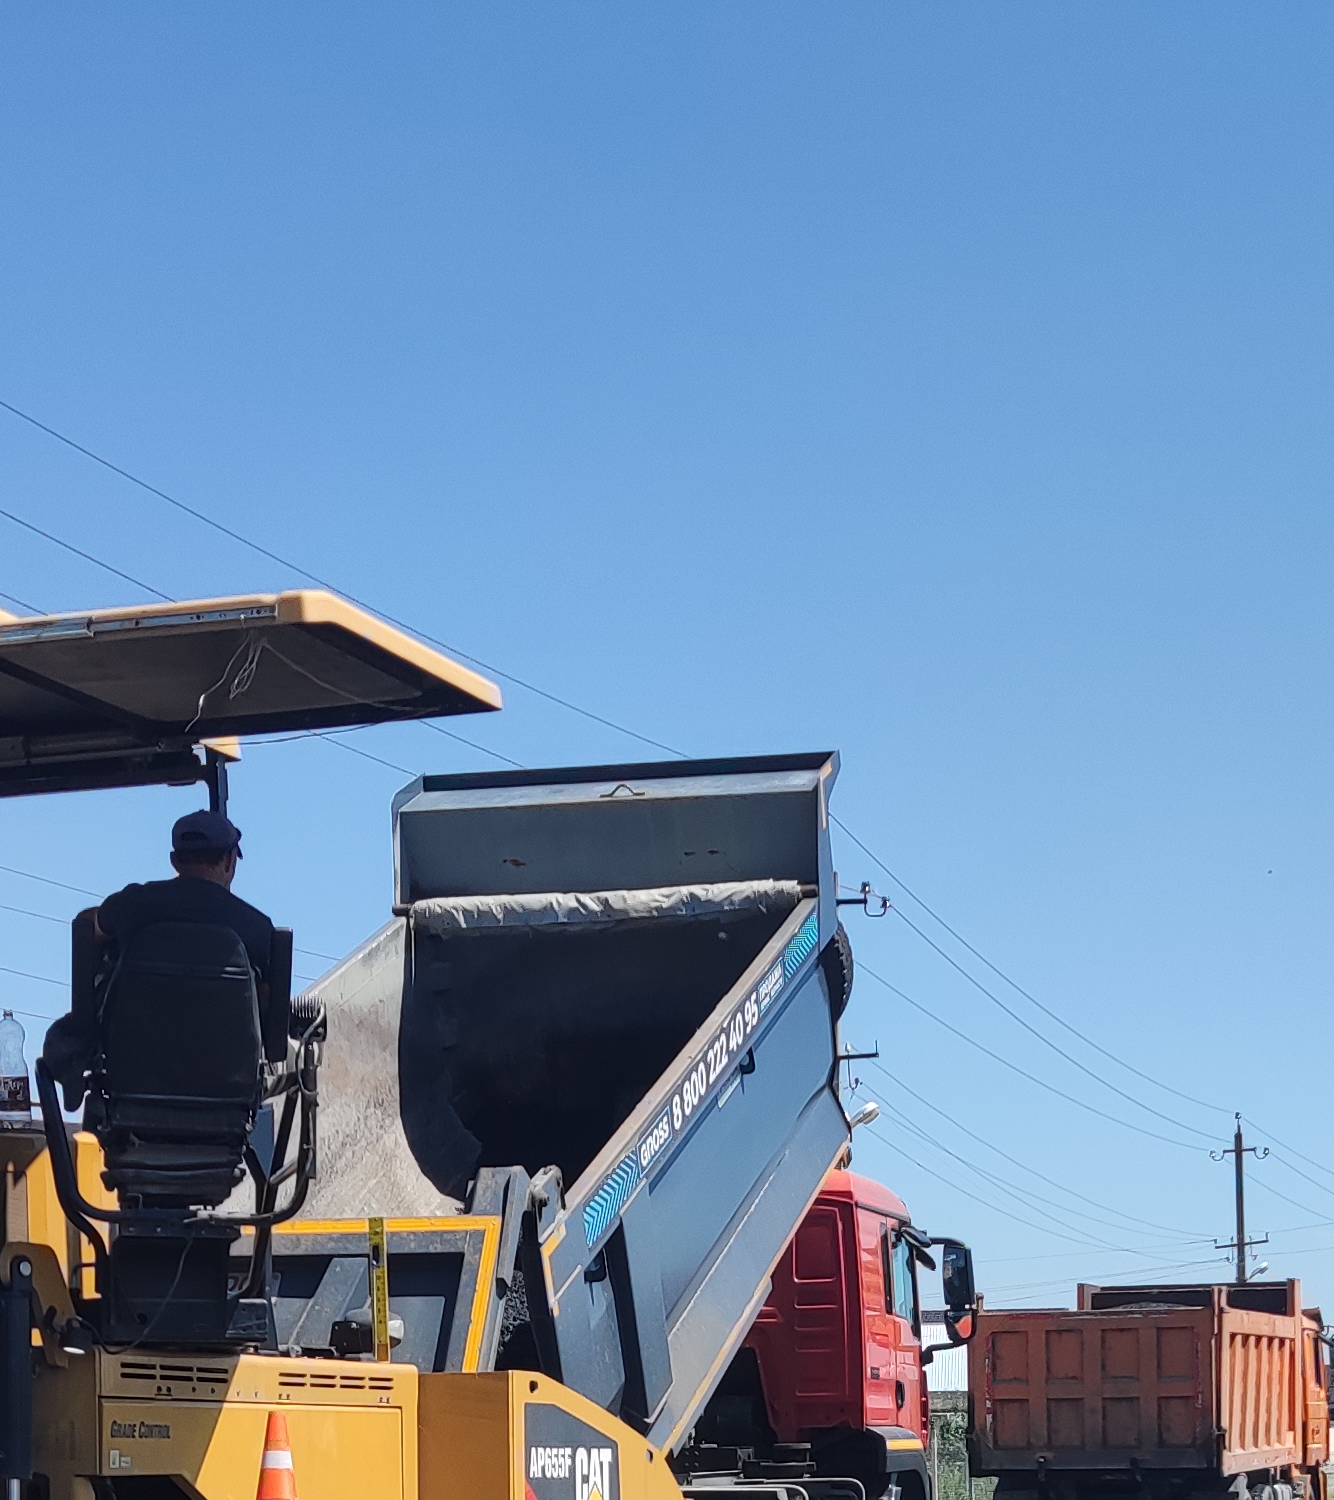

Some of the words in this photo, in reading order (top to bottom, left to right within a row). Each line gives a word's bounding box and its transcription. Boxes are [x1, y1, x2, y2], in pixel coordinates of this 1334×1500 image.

[672, 1093, 683, 1131] 8
[682, 1061, 707, 1117] 800
[707, 1032, 729, 1086] 222
[728, 1011, 744, 1052] 40
[744, 991, 759, 1035] 95
[529, 1446, 572, 1479] AP655F
